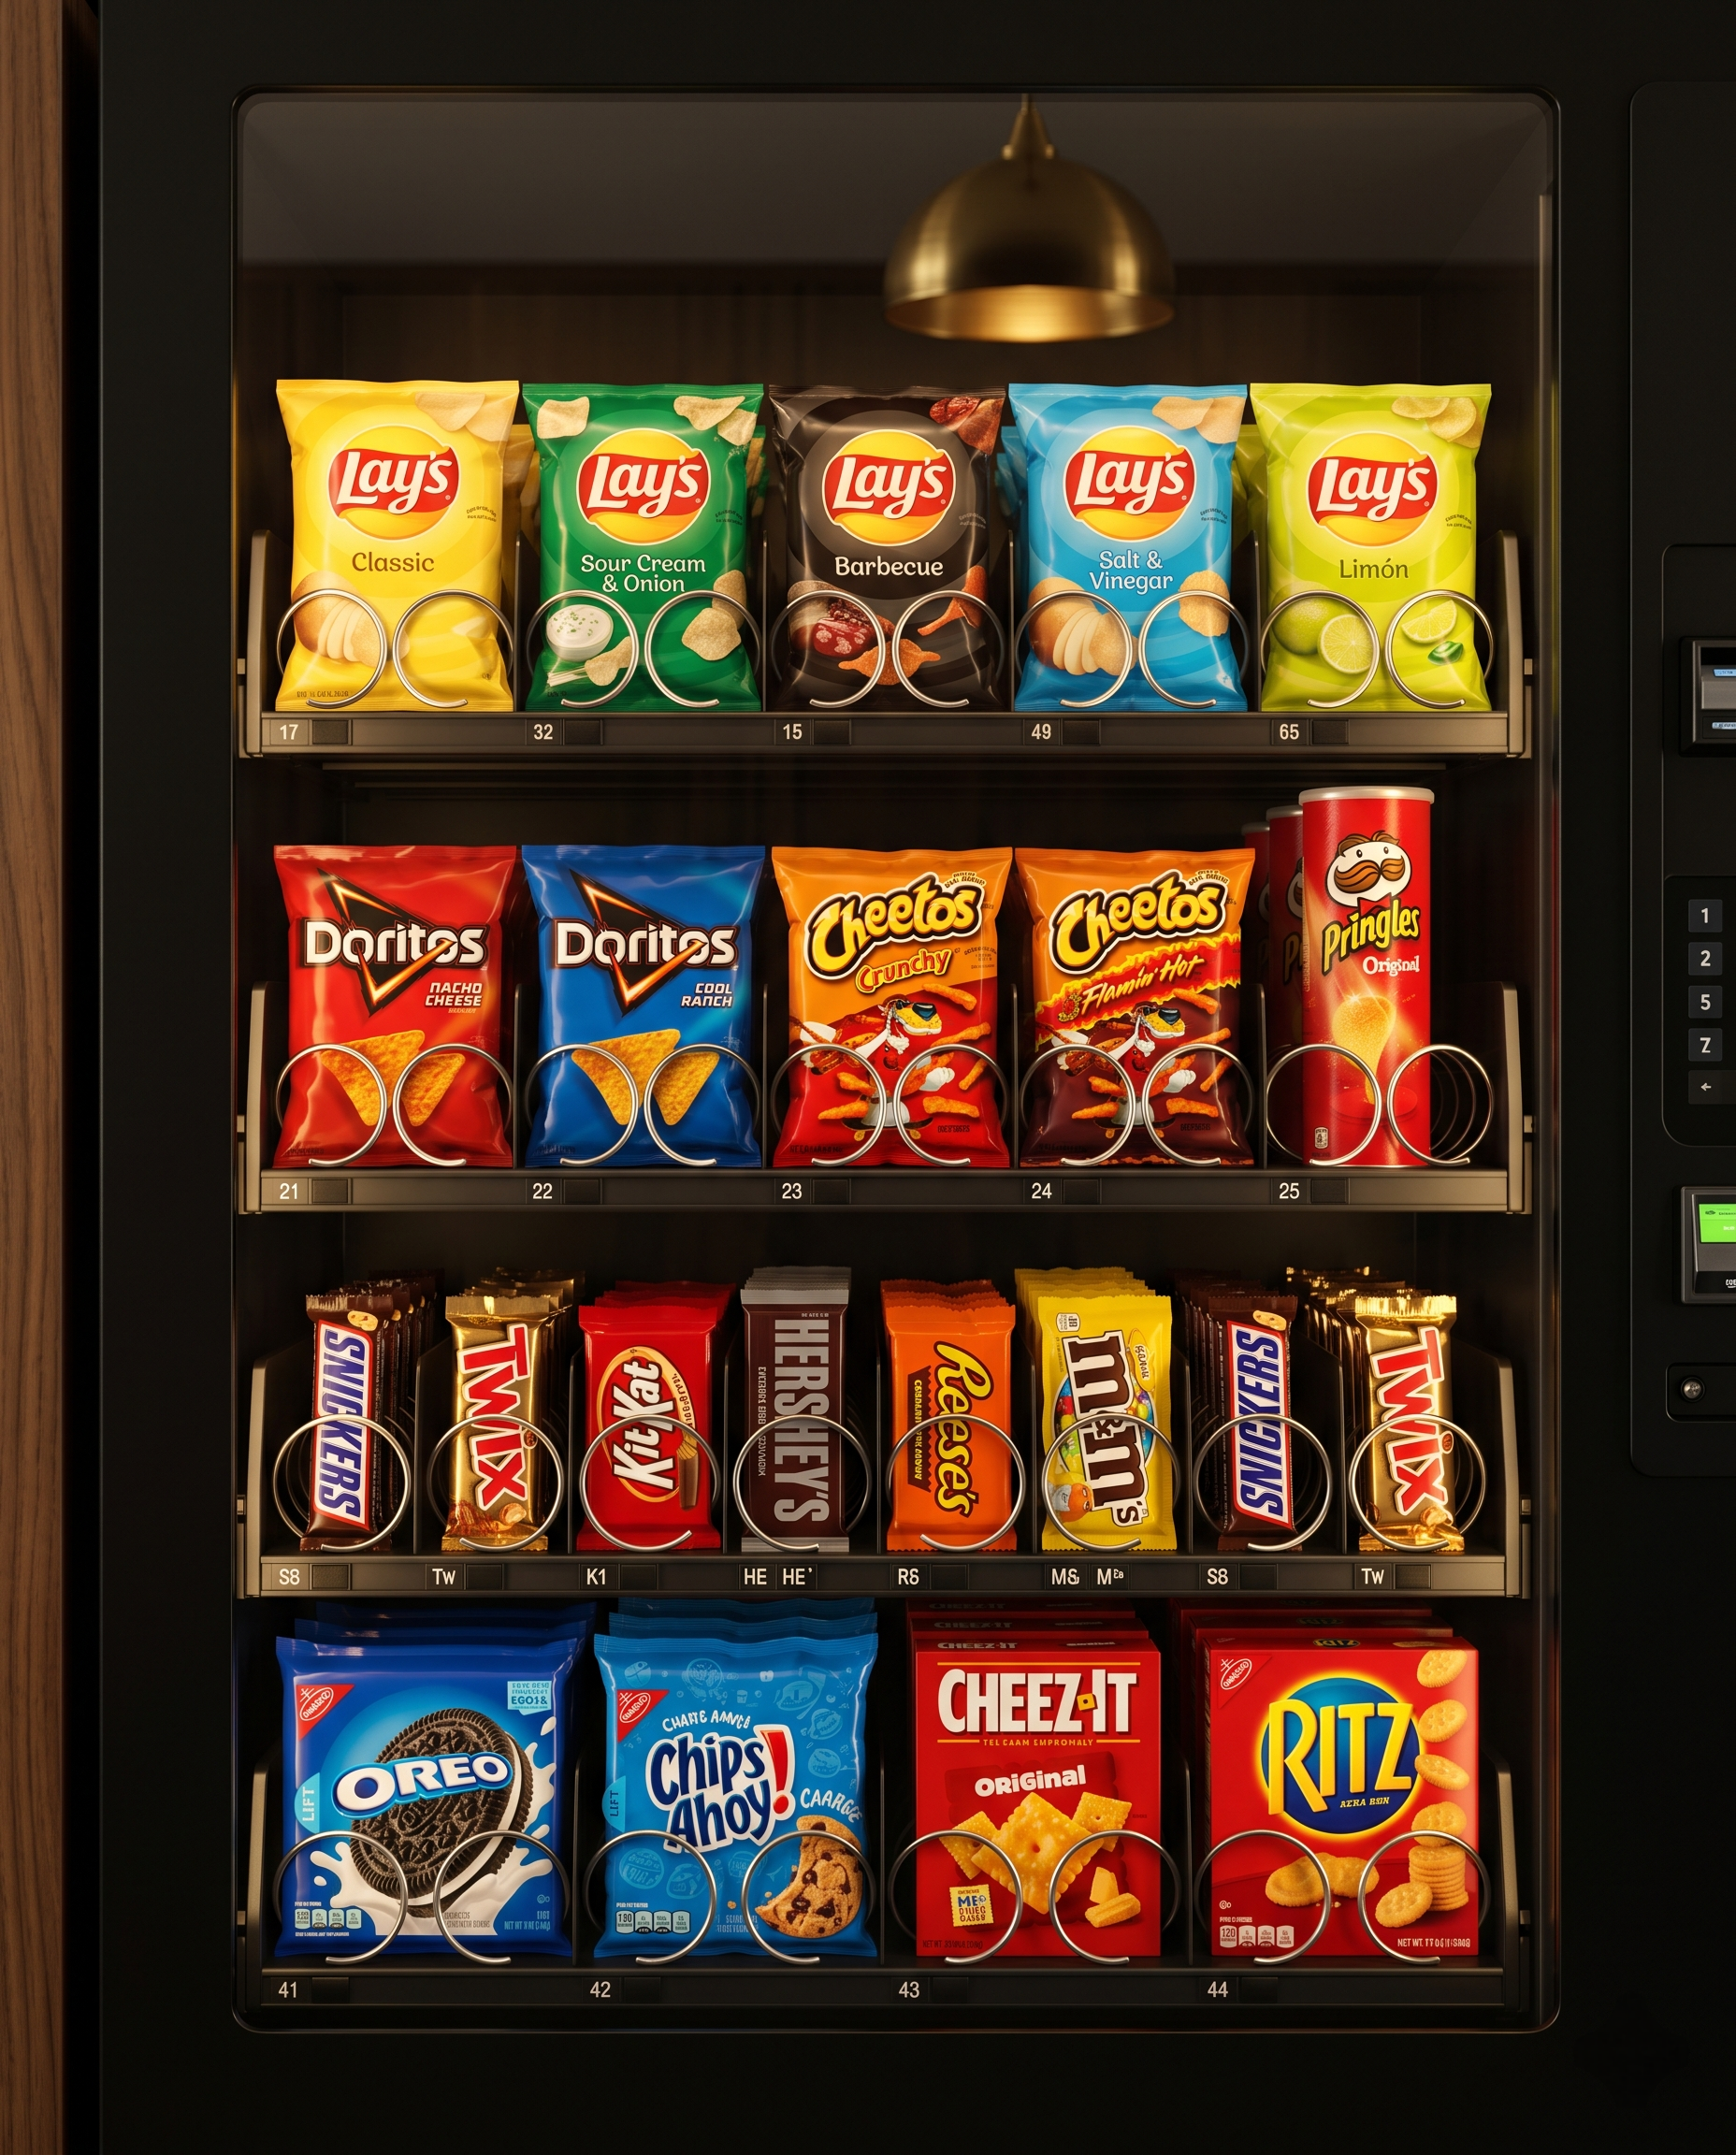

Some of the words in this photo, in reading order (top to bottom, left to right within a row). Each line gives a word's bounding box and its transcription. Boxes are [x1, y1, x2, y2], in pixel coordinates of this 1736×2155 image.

[337, 451, 453, 515] Lay's
[586, 456, 702, 518] Lay's
[832, 456, 945, 519] Lay's
[1073, 453, 1186, 515] Lay's
[1315, 459, 1432, 522] Lay's
[351, 552, 435, 573] Classic
[581, 555, 631, 573] Sour
[637, 554, 706, 573] Cream
[834, 556, 944, 577] Barbecue
[1098, 550, 1140, 571] Salt
[1146, 552, 1164, 571] &
[1339, 559, 1410, 579] Limón
[602, 574, 618, 593] &
[624, 573, 686, 593] Onion
[1089, 571, 1174, 596] Vinegar
[280, 723, 299, 741] 17
[533, 723, 554, 740] 32
[783, 723, 803, 740] 15
[1031, 723, 1051, 740] 49
[1280, 723, 1300, 740] 65
[809, 875, 980, 974] Cheetos
[1055, 875, 1222, 968] Cheetos
[1700, 907, 1709, 924] 1
[304, 918, 486, 966] Doritos
[555, 918, 737, 966] Doritos
[1322, 898, 1421, 975] Pringles
[1700, 949, 1712, 967] 2
[857, 947, 951, 992] Crunchy
[429, 982, 483, 994] NACHO
[695, 983, 732, 994] COOL
[1081, 965, 1160, 1016] Flamin'
[1159, 954, 1206, 982] Hot
[425, 994, 483, 1006] CHEESE
[681, 995, 733, 1007] RANCH
[1700, 993, 1711, 1011] 5
[279, 1182, 298, 1200] 21
[532, 1182, 553, 1200] 22
[782, 1182, 803, 1200] 23
[1031, 1182, 1052, 1199] 24
[1279, 1182, 1300, 1200] 25
[318, 1327, 367, 1520] SNICKERS
[774, 1319, 830, 1522] HERSHEY'S
[935, 1343, 992, 1515] Reese's
[1236, 1328, 1284, 1518] SNICKERS
[279, 1568, 301, 1585] S8
[431, 1568, 456, 1585] Tw
[586, 1568, 606, 1585] K1
[744, 1568, 767, 1585] HE
[1207, 1568, 1229, 1585] S8
[1361, 1568, 1384, 1584] Tw
[1268, 1698, 1414, 1815] RITZ
[650, 1734, 766, 1806] Chips
[336, 1756, 509, 1812] OREO
[302, 1786, 315, 1821] LIFT
[610, 1789, 619, 1817] LIFT
[1221, 1928, 1236, 1938] 120
[1397, 1938, 1411, 1947] NET
[278, 1981, 297, 1999] 41
[589, 1981, 611, 1998] 42
[898, 1981, 920, 1999] 43
[1207, 1981, 1229, 1998] 44
